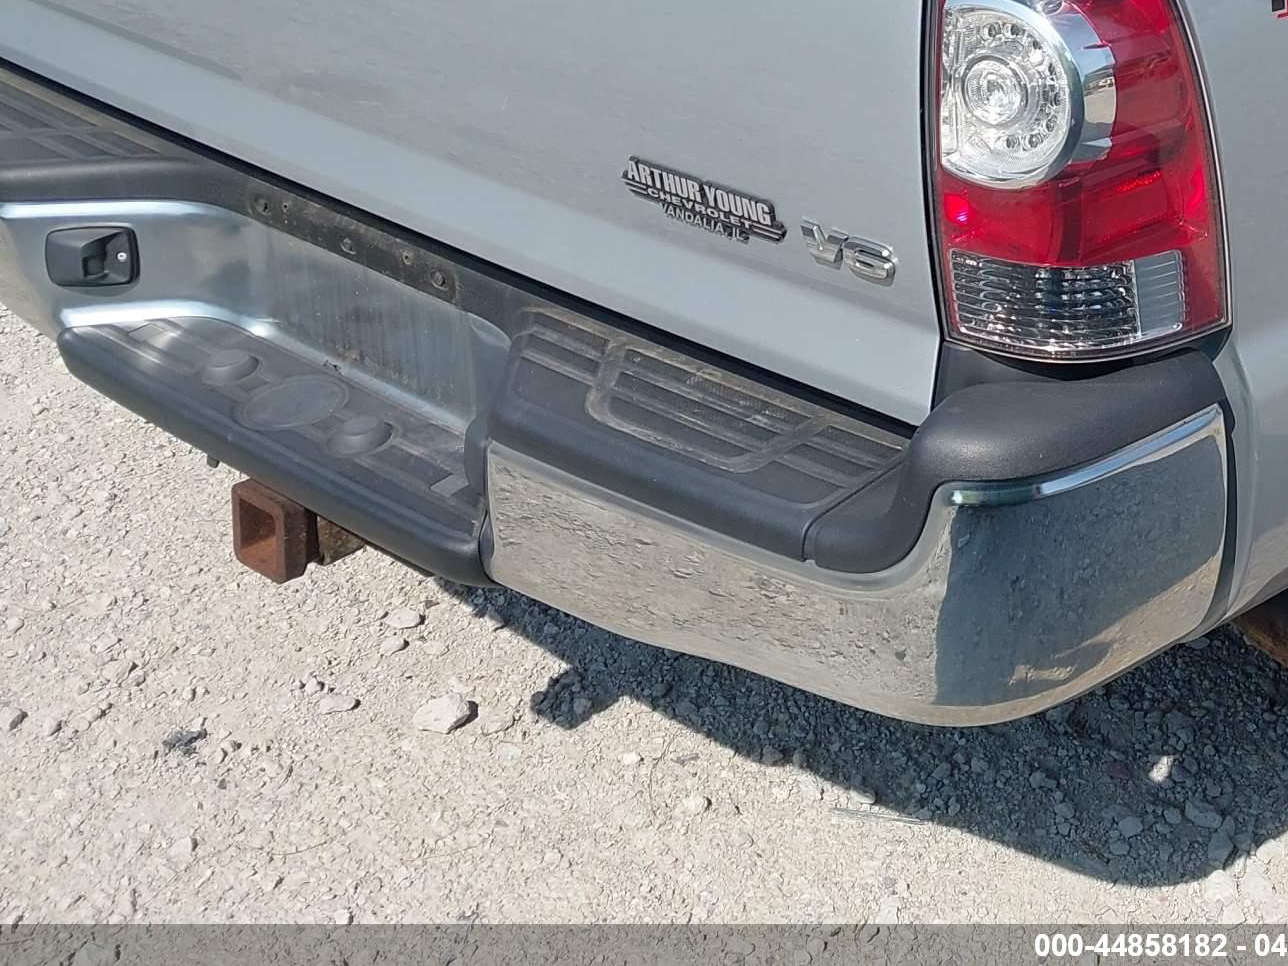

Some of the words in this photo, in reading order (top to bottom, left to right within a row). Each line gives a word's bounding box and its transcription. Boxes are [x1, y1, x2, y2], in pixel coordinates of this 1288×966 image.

[626, 160, 703, 203] ARTHUR
[703, 181, 773, 227] YOUNG
[647, 188, 753, 229] CHEVROLET
[660, 203, 729, 237] VANDALIA,
[800, 215, 899, 287] V6
